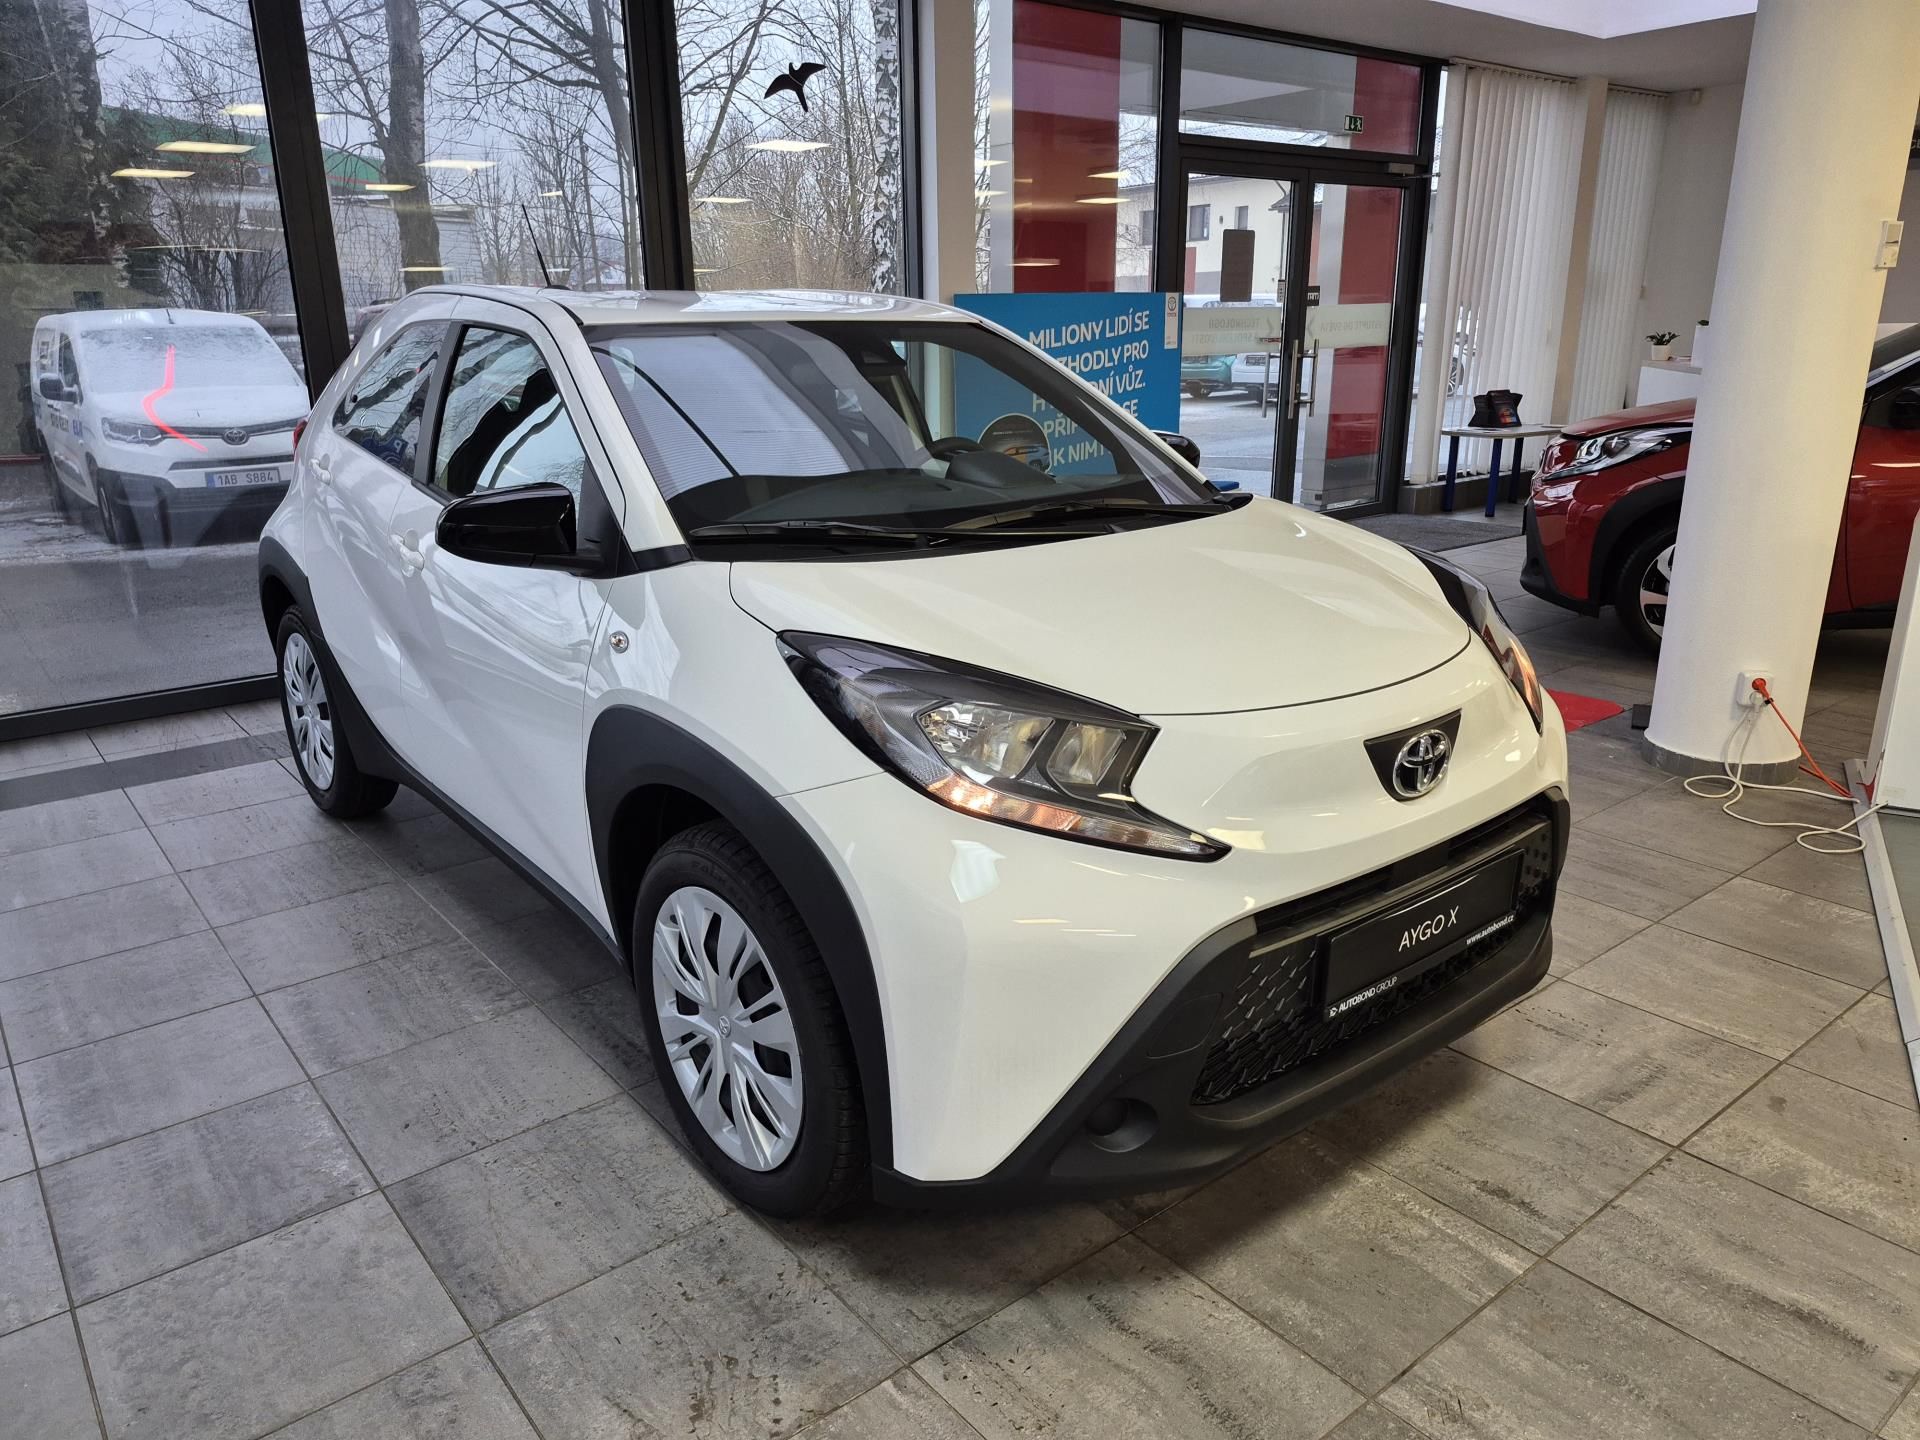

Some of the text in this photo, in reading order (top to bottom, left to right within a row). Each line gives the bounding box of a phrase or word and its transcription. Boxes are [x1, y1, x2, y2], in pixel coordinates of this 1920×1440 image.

[1029, 307, 1150, 349] MILIONY LIDÍ SE
[1123, 339, 1149, 363] PRO
[1053, 447, 1065, 466] K
[1068, 439, 1098, 463] NIM
[218, 474, 238, 486] 1AB
[1398, 905, 1459, 952] AYGO X
[1338, 976, 1398, 1013] AUTOBOND GROUP
